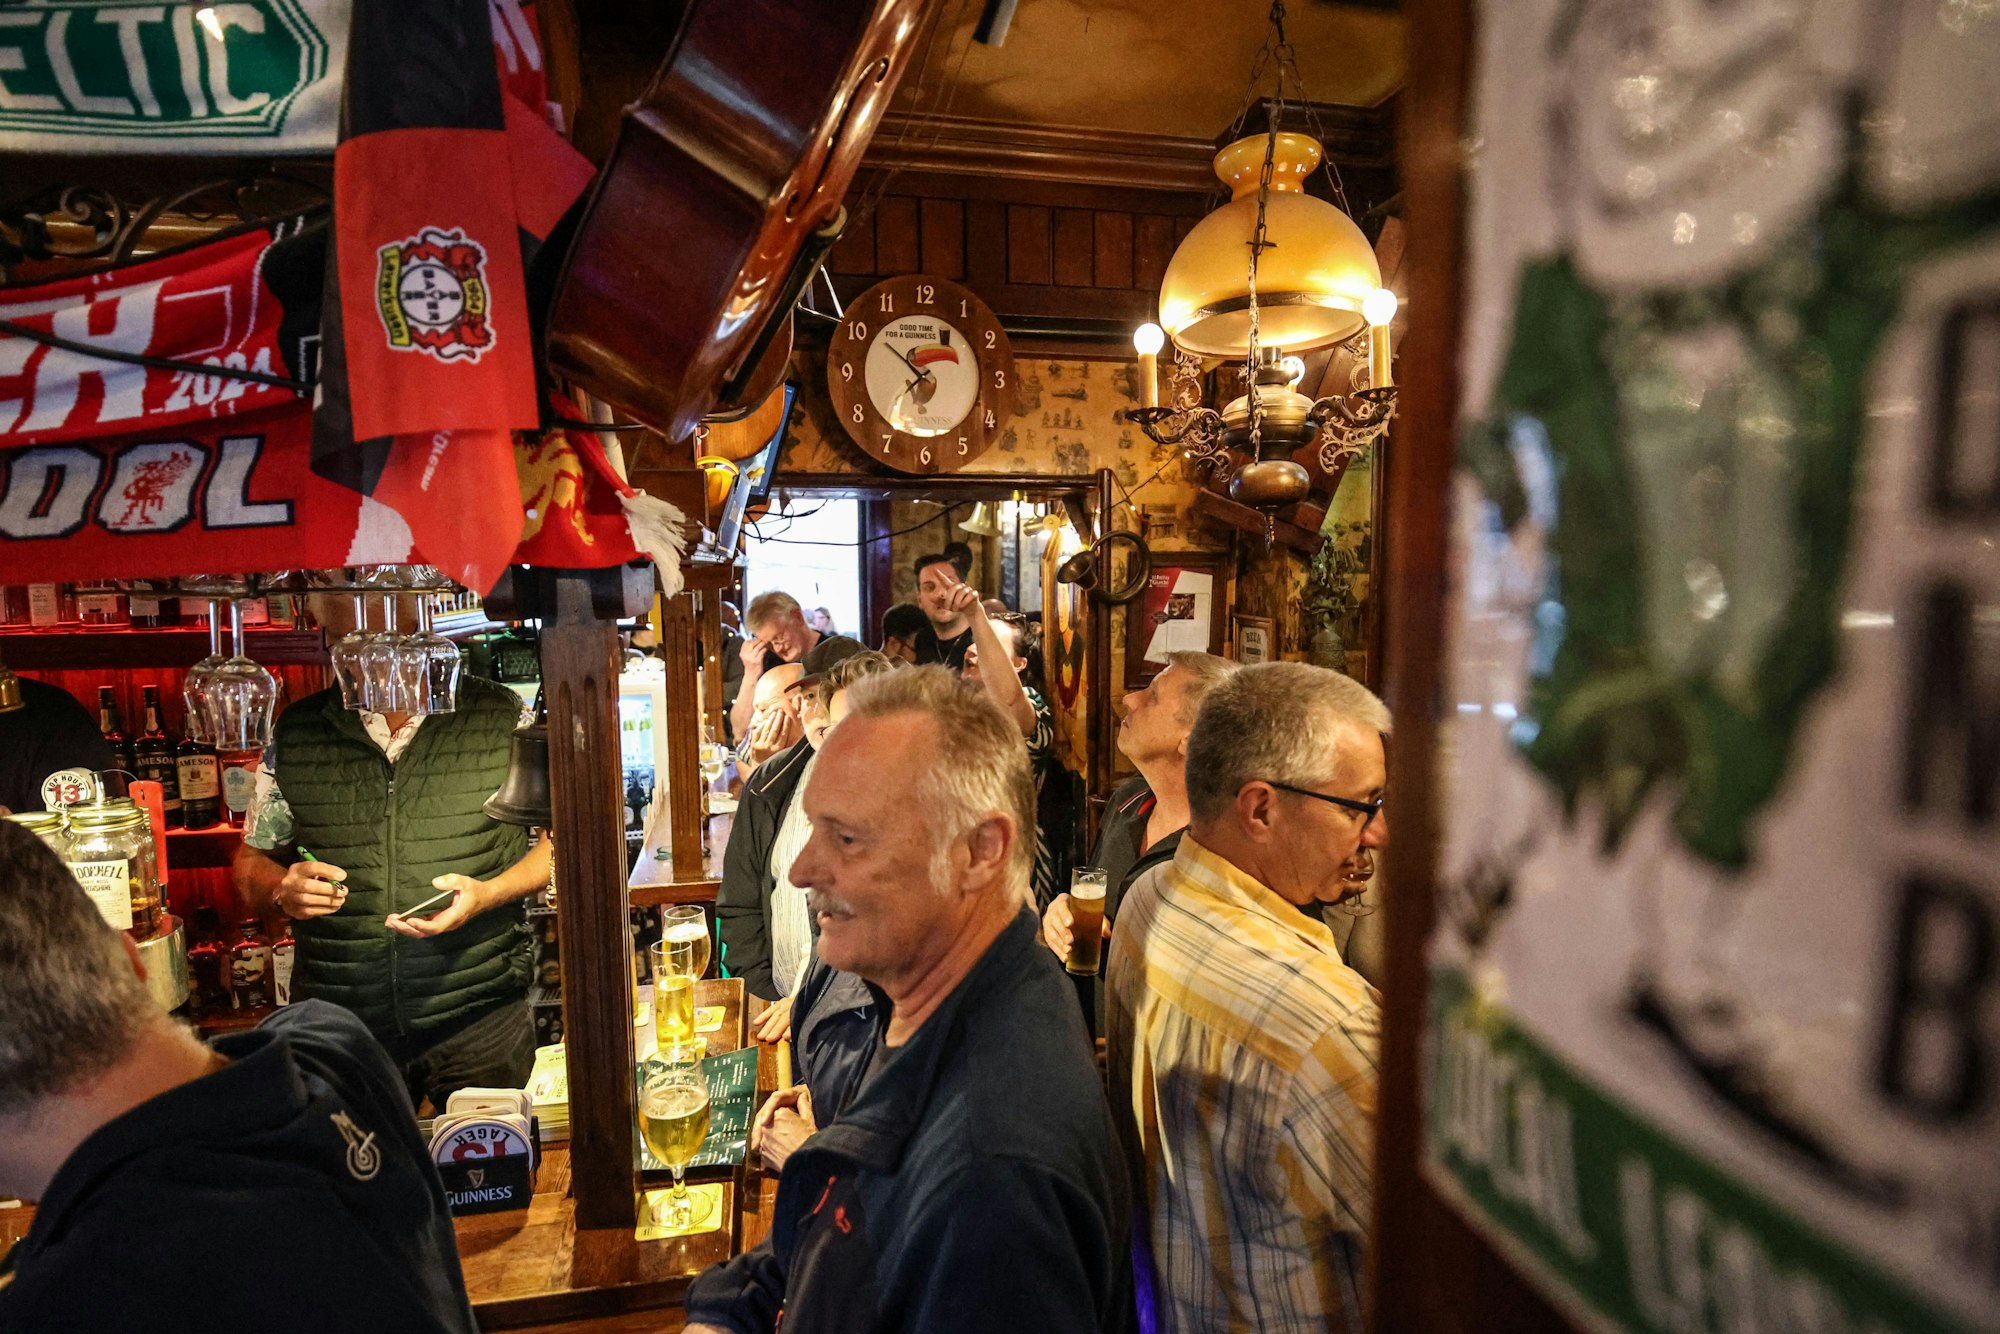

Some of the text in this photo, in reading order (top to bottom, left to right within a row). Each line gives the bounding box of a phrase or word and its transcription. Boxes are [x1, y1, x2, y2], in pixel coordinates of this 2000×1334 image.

[422, 269, 440, 321] BAYER
[880, 293, 893, 312] 11
[916, 285, 934, 304] 12
[960, 299, 967, 318] 1
[848, 321, 867, 341] 10
[985, 331, 996, 349] 2
[165, 347, 277, 413] 2024
[841, 362, 853, 382] 9
[994, 370, 1005, 389] 3
[853, 404, 864, 423] 8
[985, 409, 996, 428] 4
[882, 434, 892, 453] 7
[958, 437, 968, 456] 5
[920, 446, 931, 465] 6
[61, 775, 85, 791] HOUSE
[52, 784, 80, 802] 13
[454, 1129, 510, 1145] LAGER
[446, 1186, 513, 1206] GUINNESS
